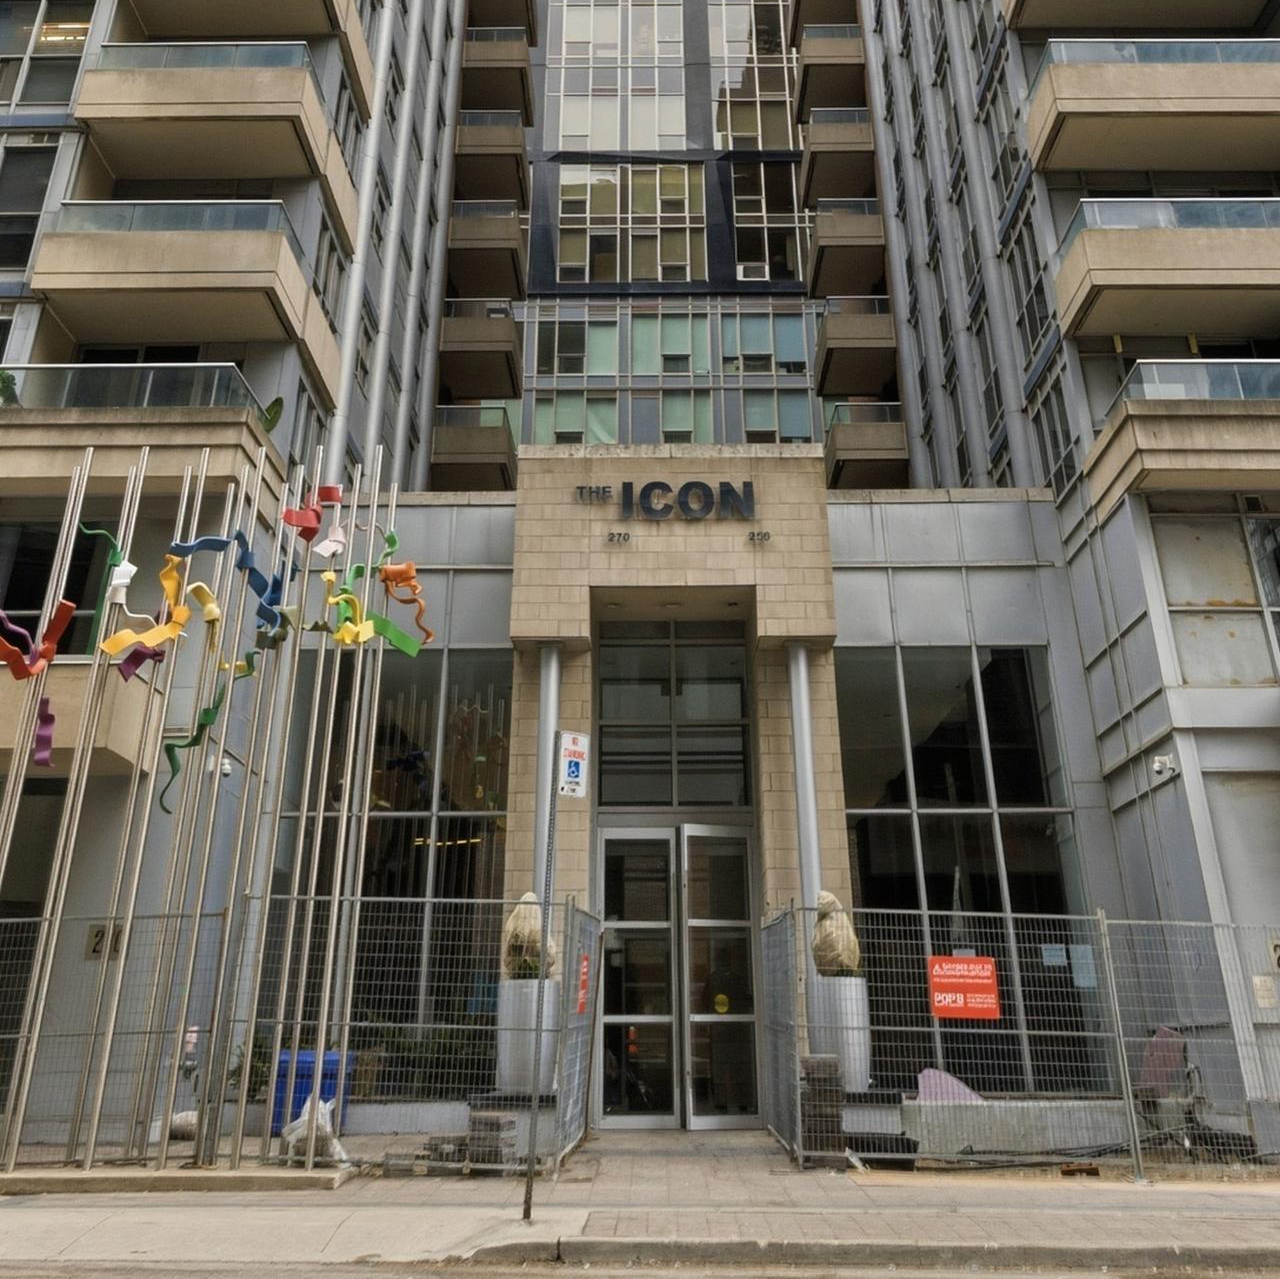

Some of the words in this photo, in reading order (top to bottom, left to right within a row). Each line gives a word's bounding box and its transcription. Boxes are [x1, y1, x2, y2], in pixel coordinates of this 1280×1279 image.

[576, 485, 612, 502] THE
[622, 480, 754, 521] ICON
[607, 532, 630, 543] 270
